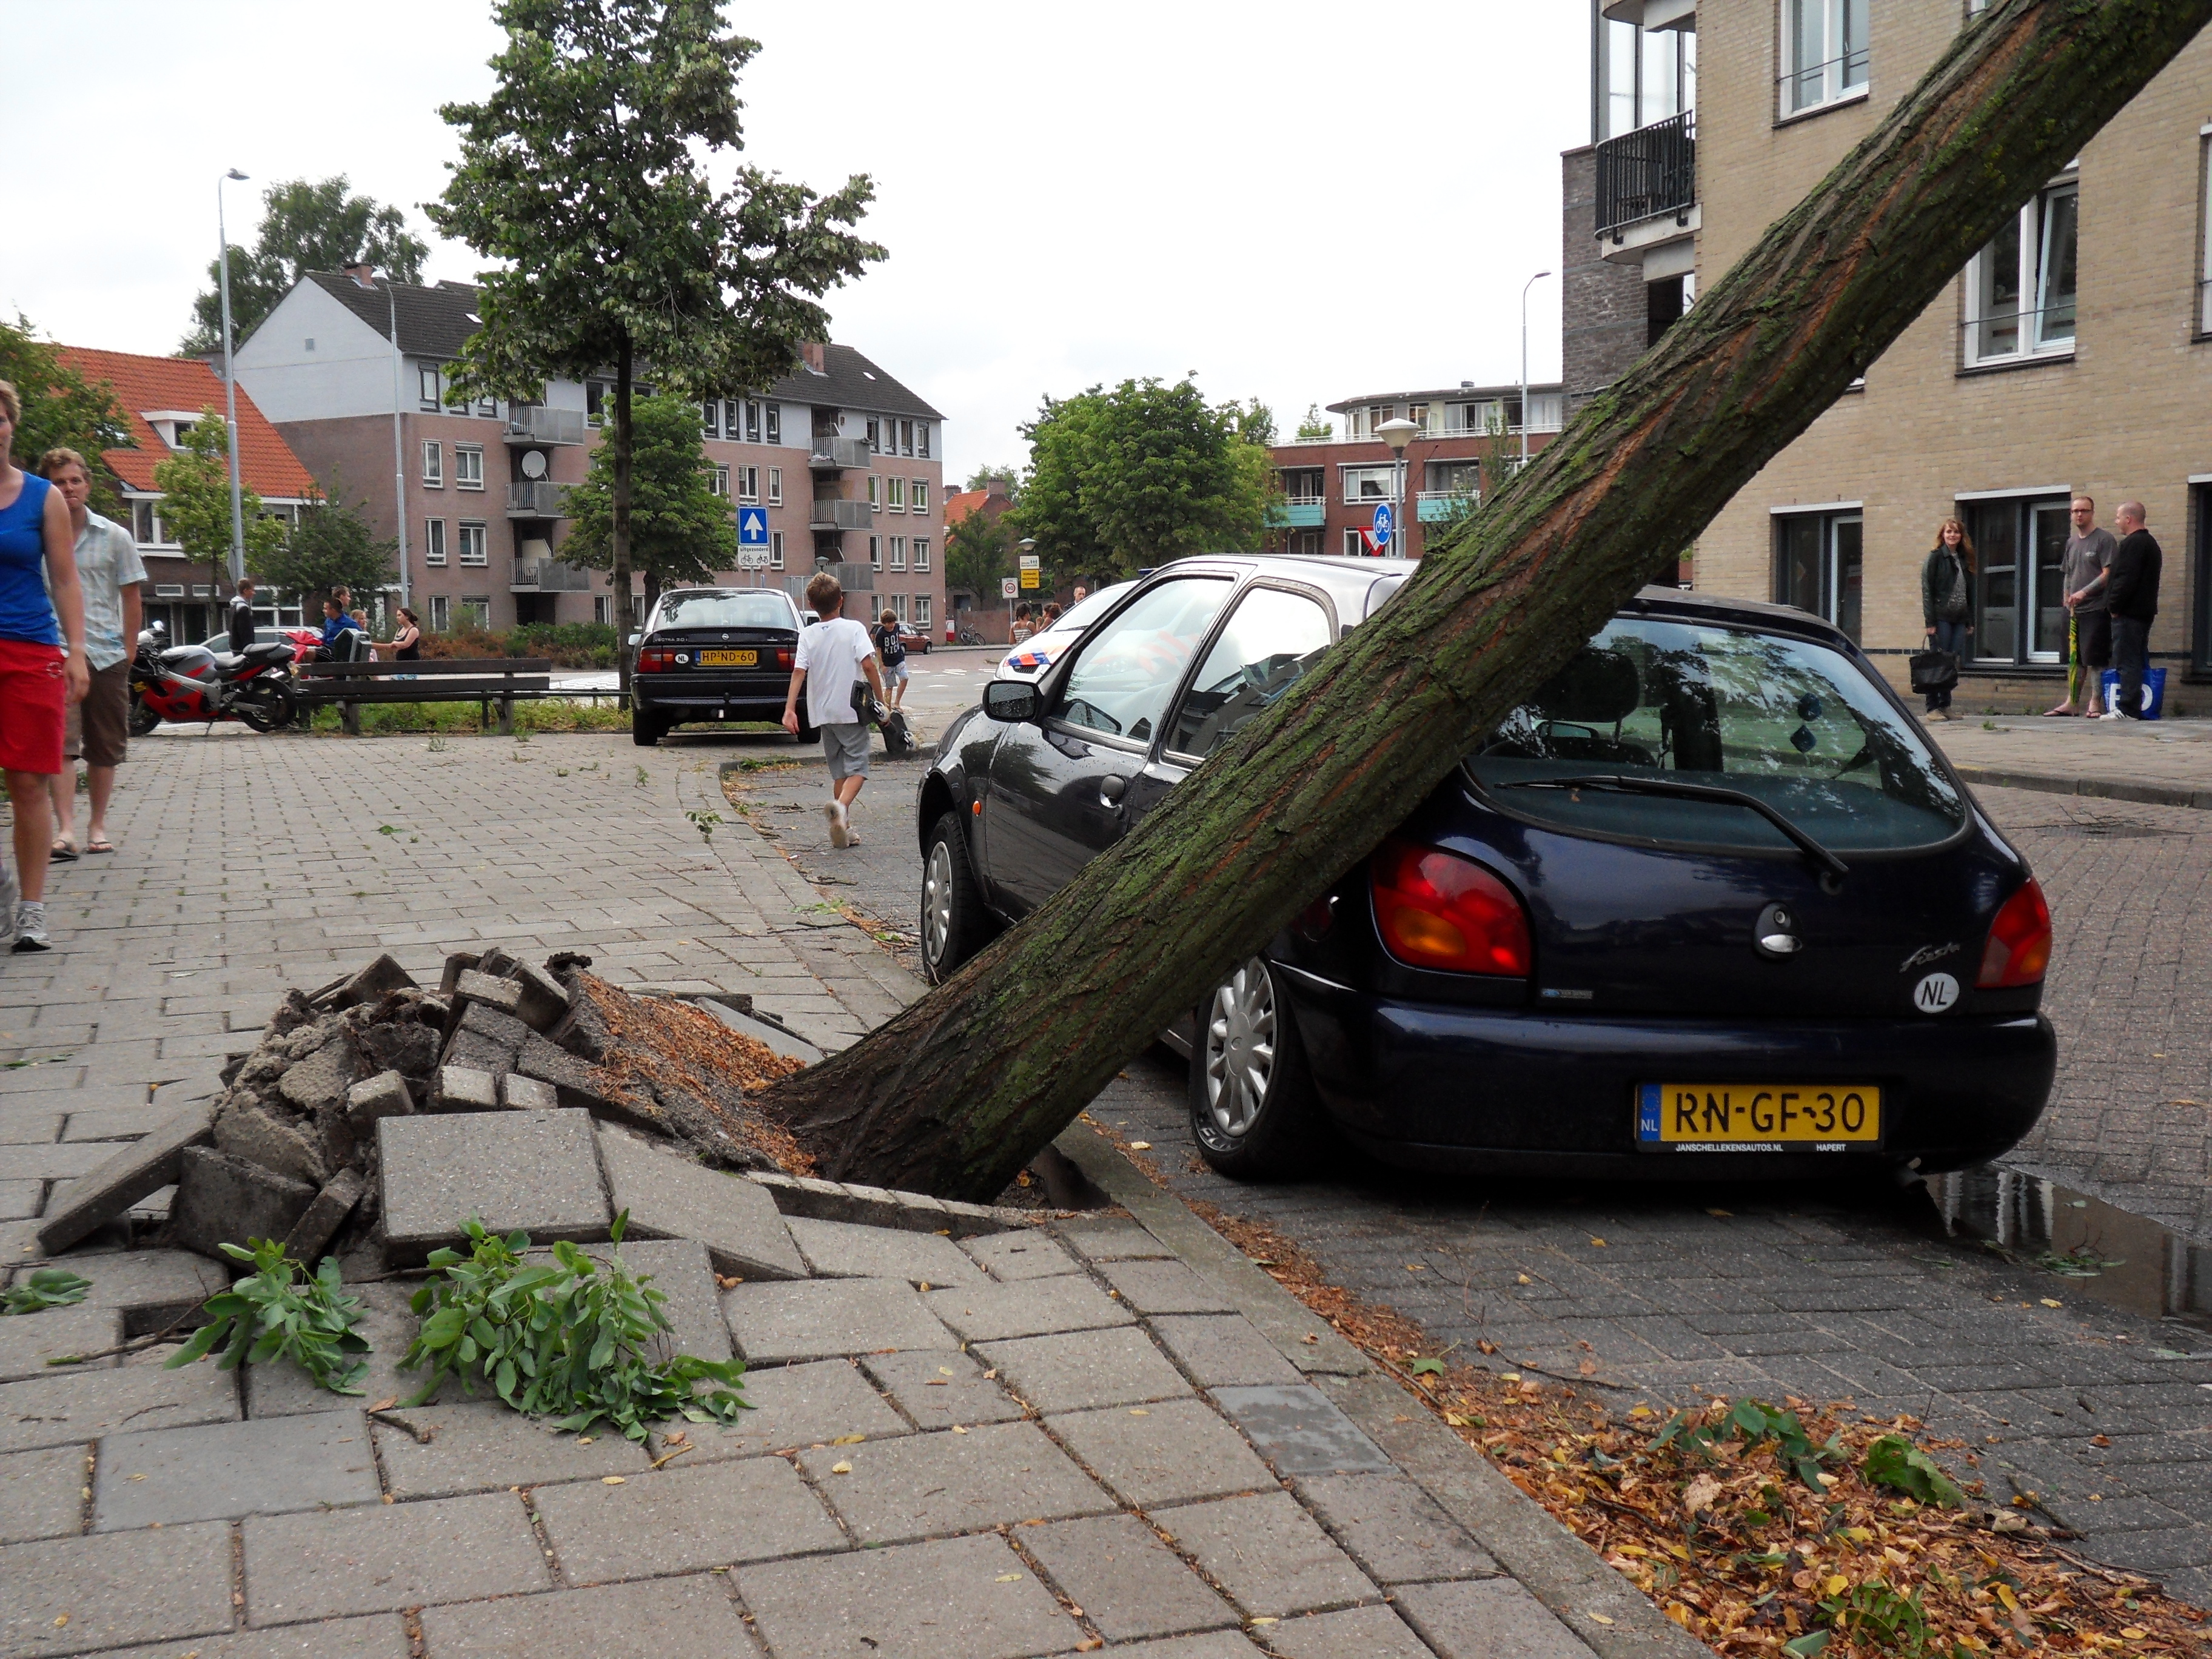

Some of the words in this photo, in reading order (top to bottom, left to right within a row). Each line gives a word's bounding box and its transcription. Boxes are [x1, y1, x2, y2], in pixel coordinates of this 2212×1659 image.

[702, 651, 755, 662] HP-ND-60
[1920, 981, 1948, 1006] NL
[1675, 1093, 1866, 1133] RN-GF-30
[1640, 1118, 1658, 1131] NL
[1675, 1143, 1784, 1152] JANSCHELLEKENSAUTOS.NL
[1816, 1143, 1847, 1152] HAPERT
